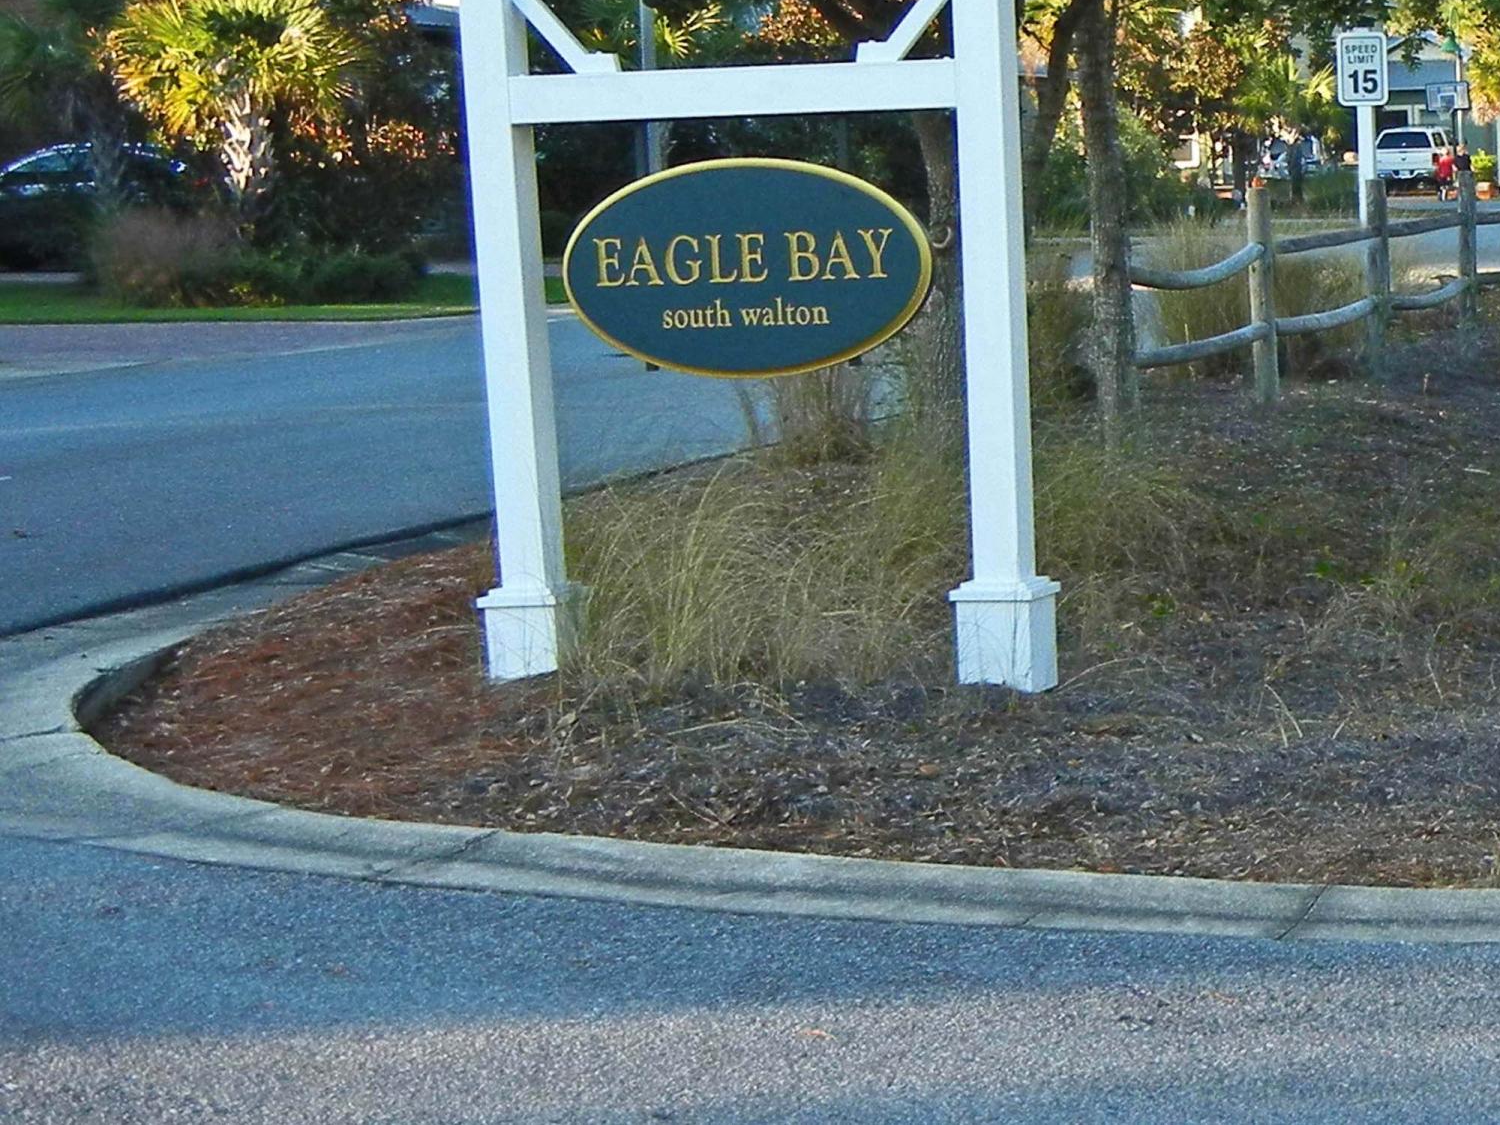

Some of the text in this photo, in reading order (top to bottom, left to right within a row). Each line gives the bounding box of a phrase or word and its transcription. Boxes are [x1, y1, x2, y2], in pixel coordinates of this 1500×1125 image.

[1344, 45, 1377, 53] SPEED
[1348, 55, 1374, 64] LIMIT
[1348, 70, 1378, 94] 15
[593, 228, 893, 287] EAGLE BAY
[662, 295, 829, 330] south walton
